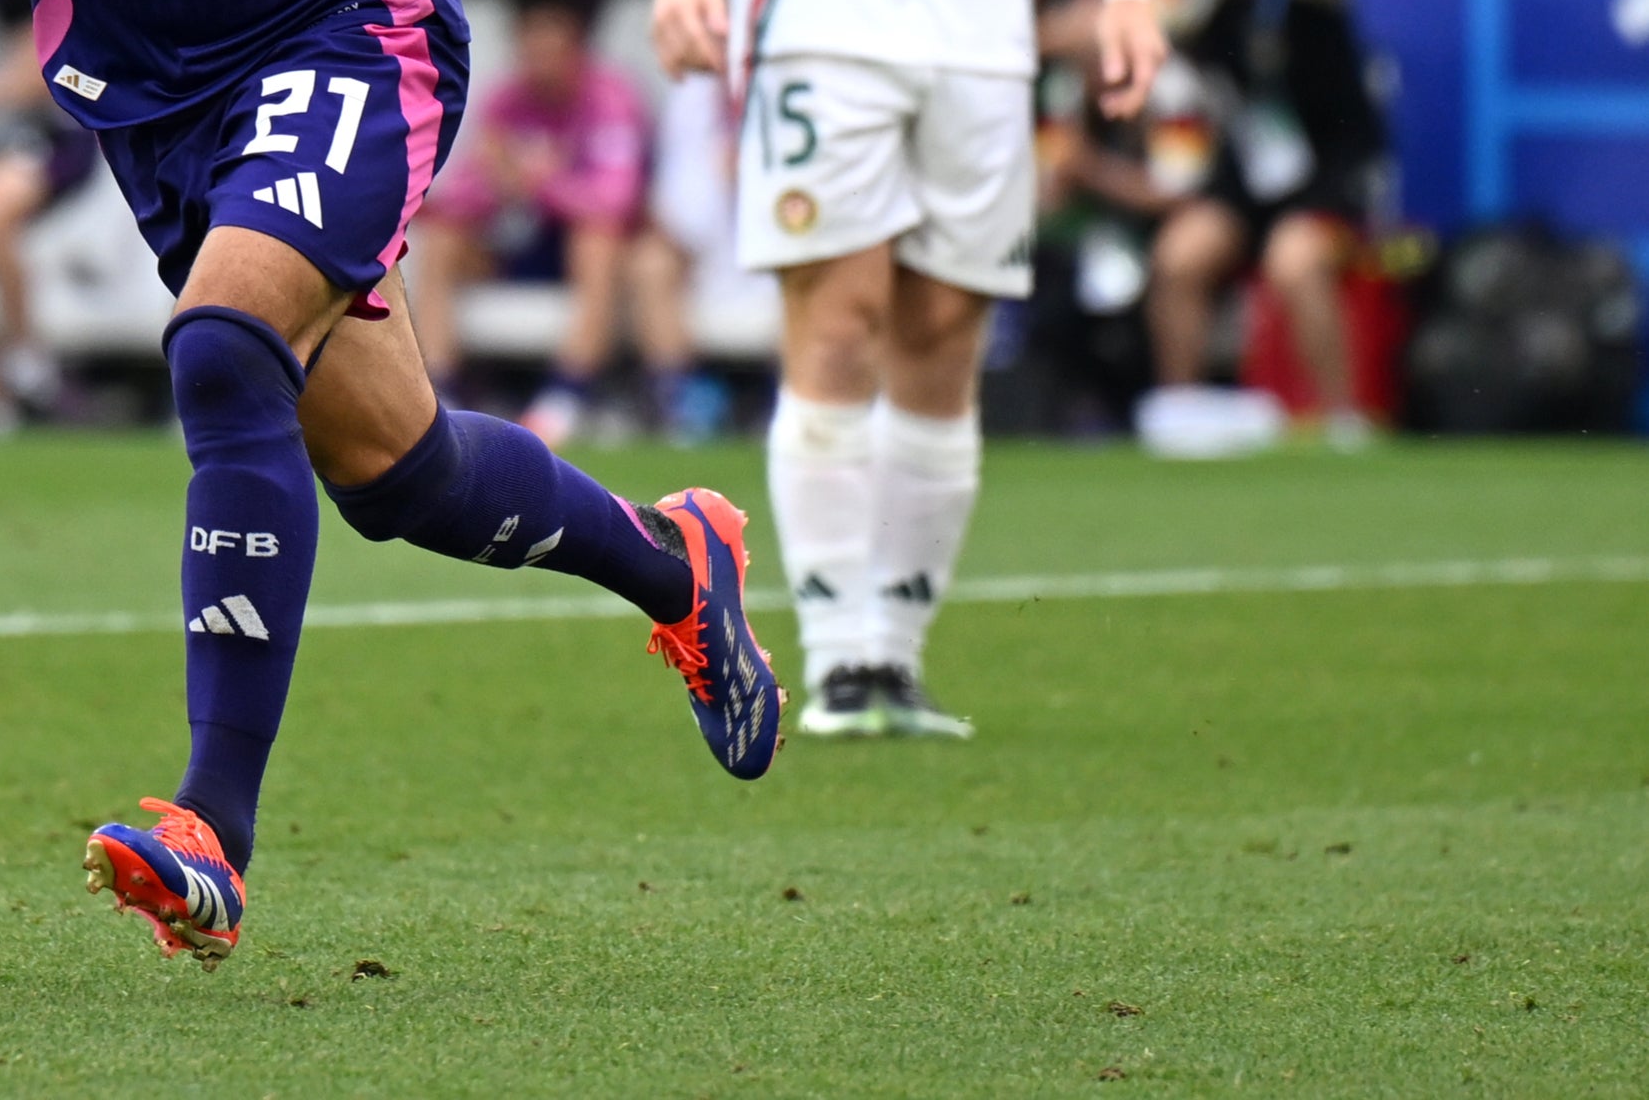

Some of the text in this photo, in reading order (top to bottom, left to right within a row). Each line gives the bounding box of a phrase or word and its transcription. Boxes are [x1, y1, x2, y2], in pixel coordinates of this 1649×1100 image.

[241, 69, 370, 175] 21
[759, 81, 817, 169] 15
[190, 526, 280, 557] DFB
[471, 514, 520, 563] FB
